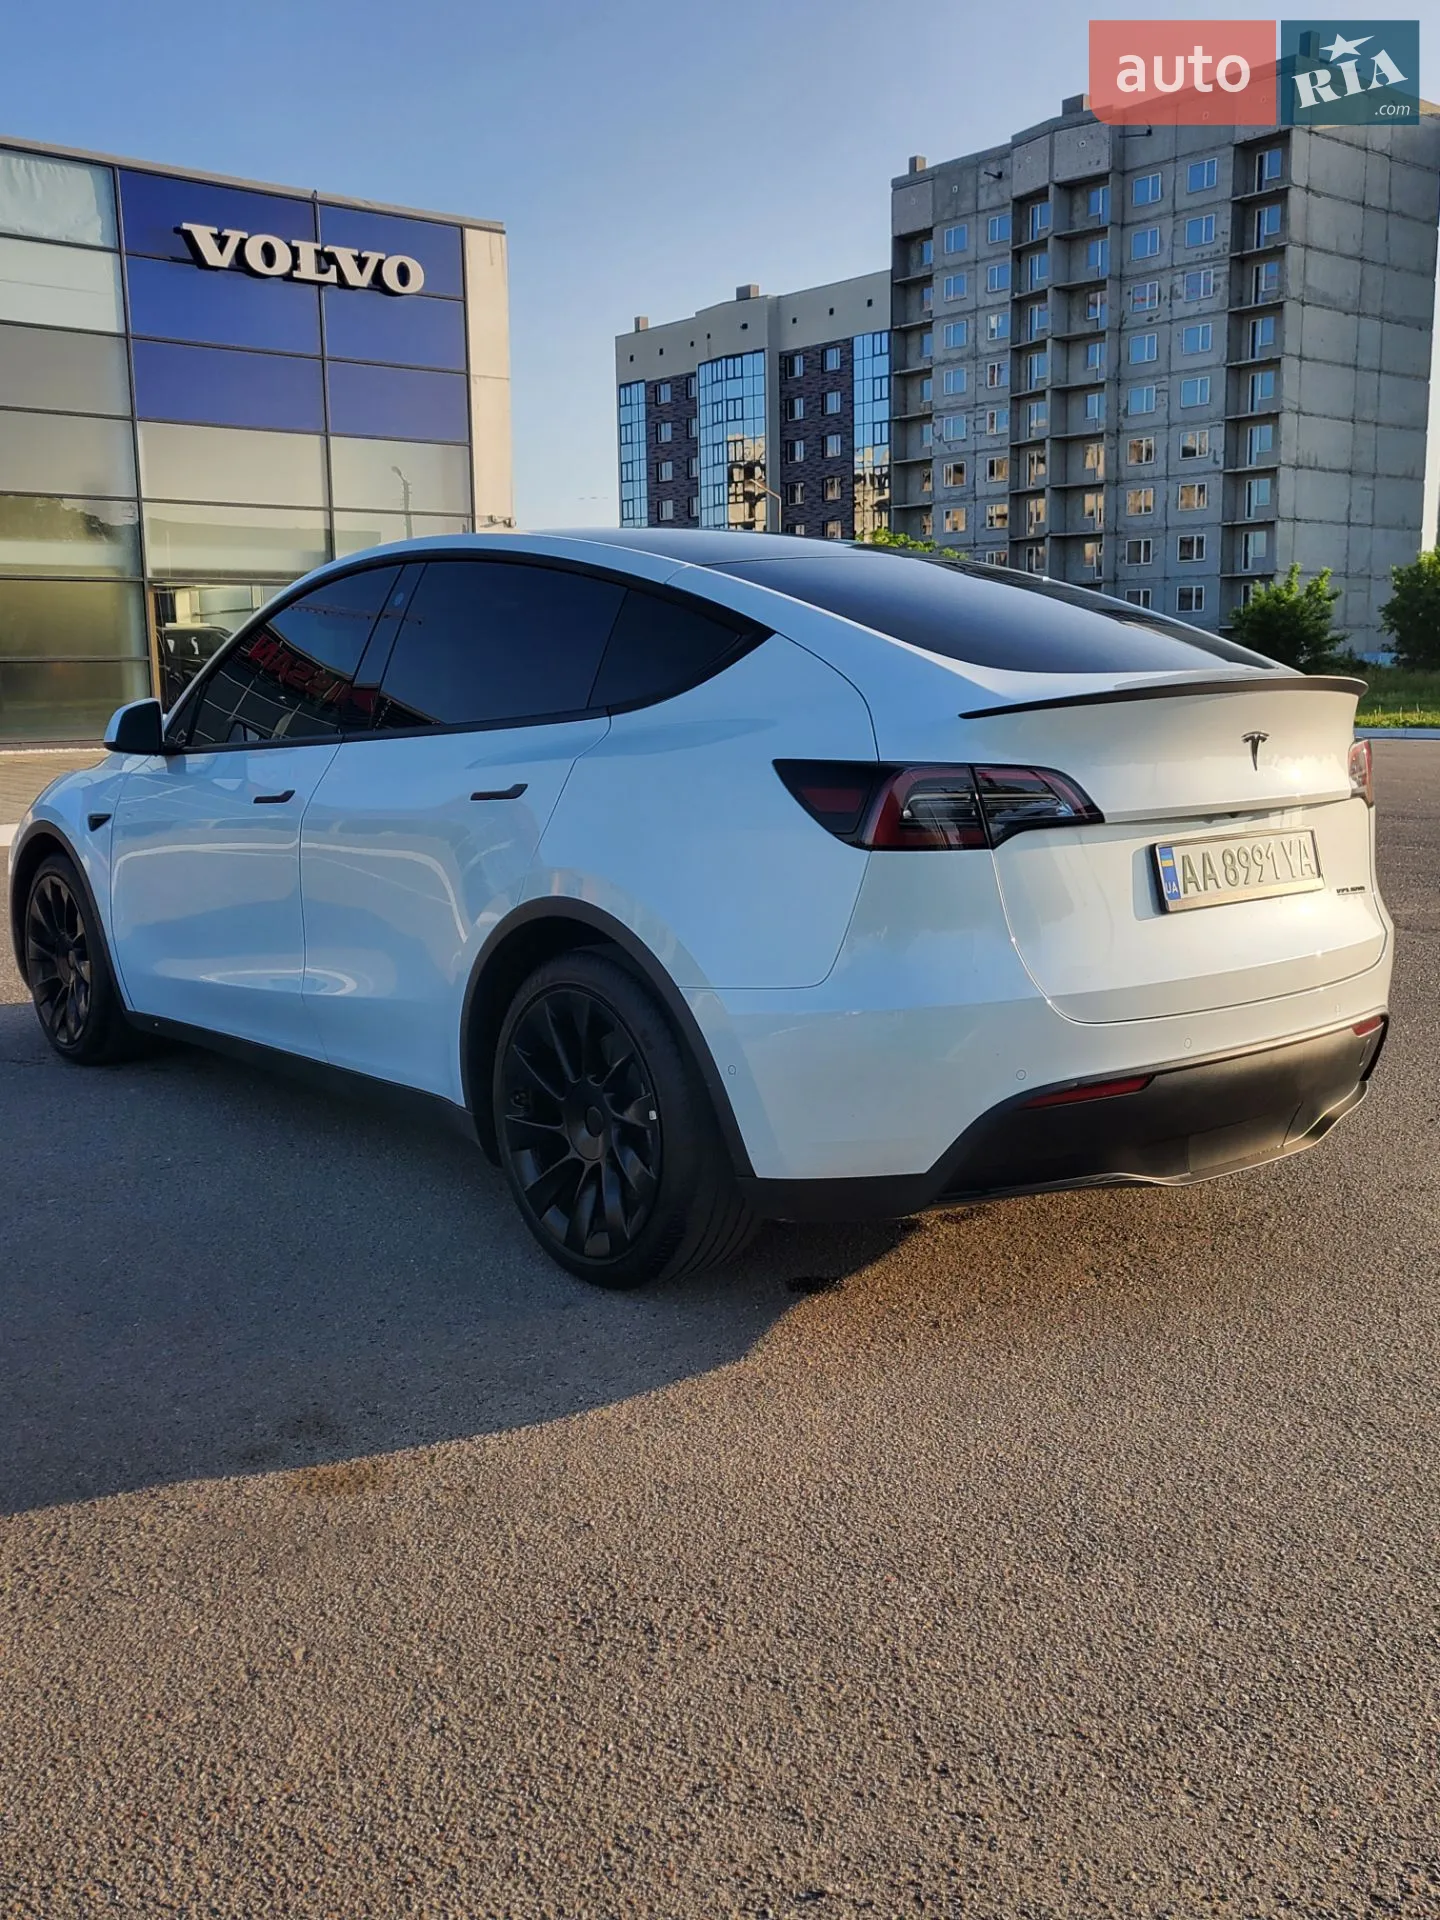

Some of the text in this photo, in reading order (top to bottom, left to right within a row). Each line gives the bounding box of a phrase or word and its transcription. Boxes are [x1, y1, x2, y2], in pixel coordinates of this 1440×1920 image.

[181, 222, 426, 295] VOLVO
[1165, 881, 1179, 895] UA
[1181, 837, 1316, 895] AA 8991 YA
